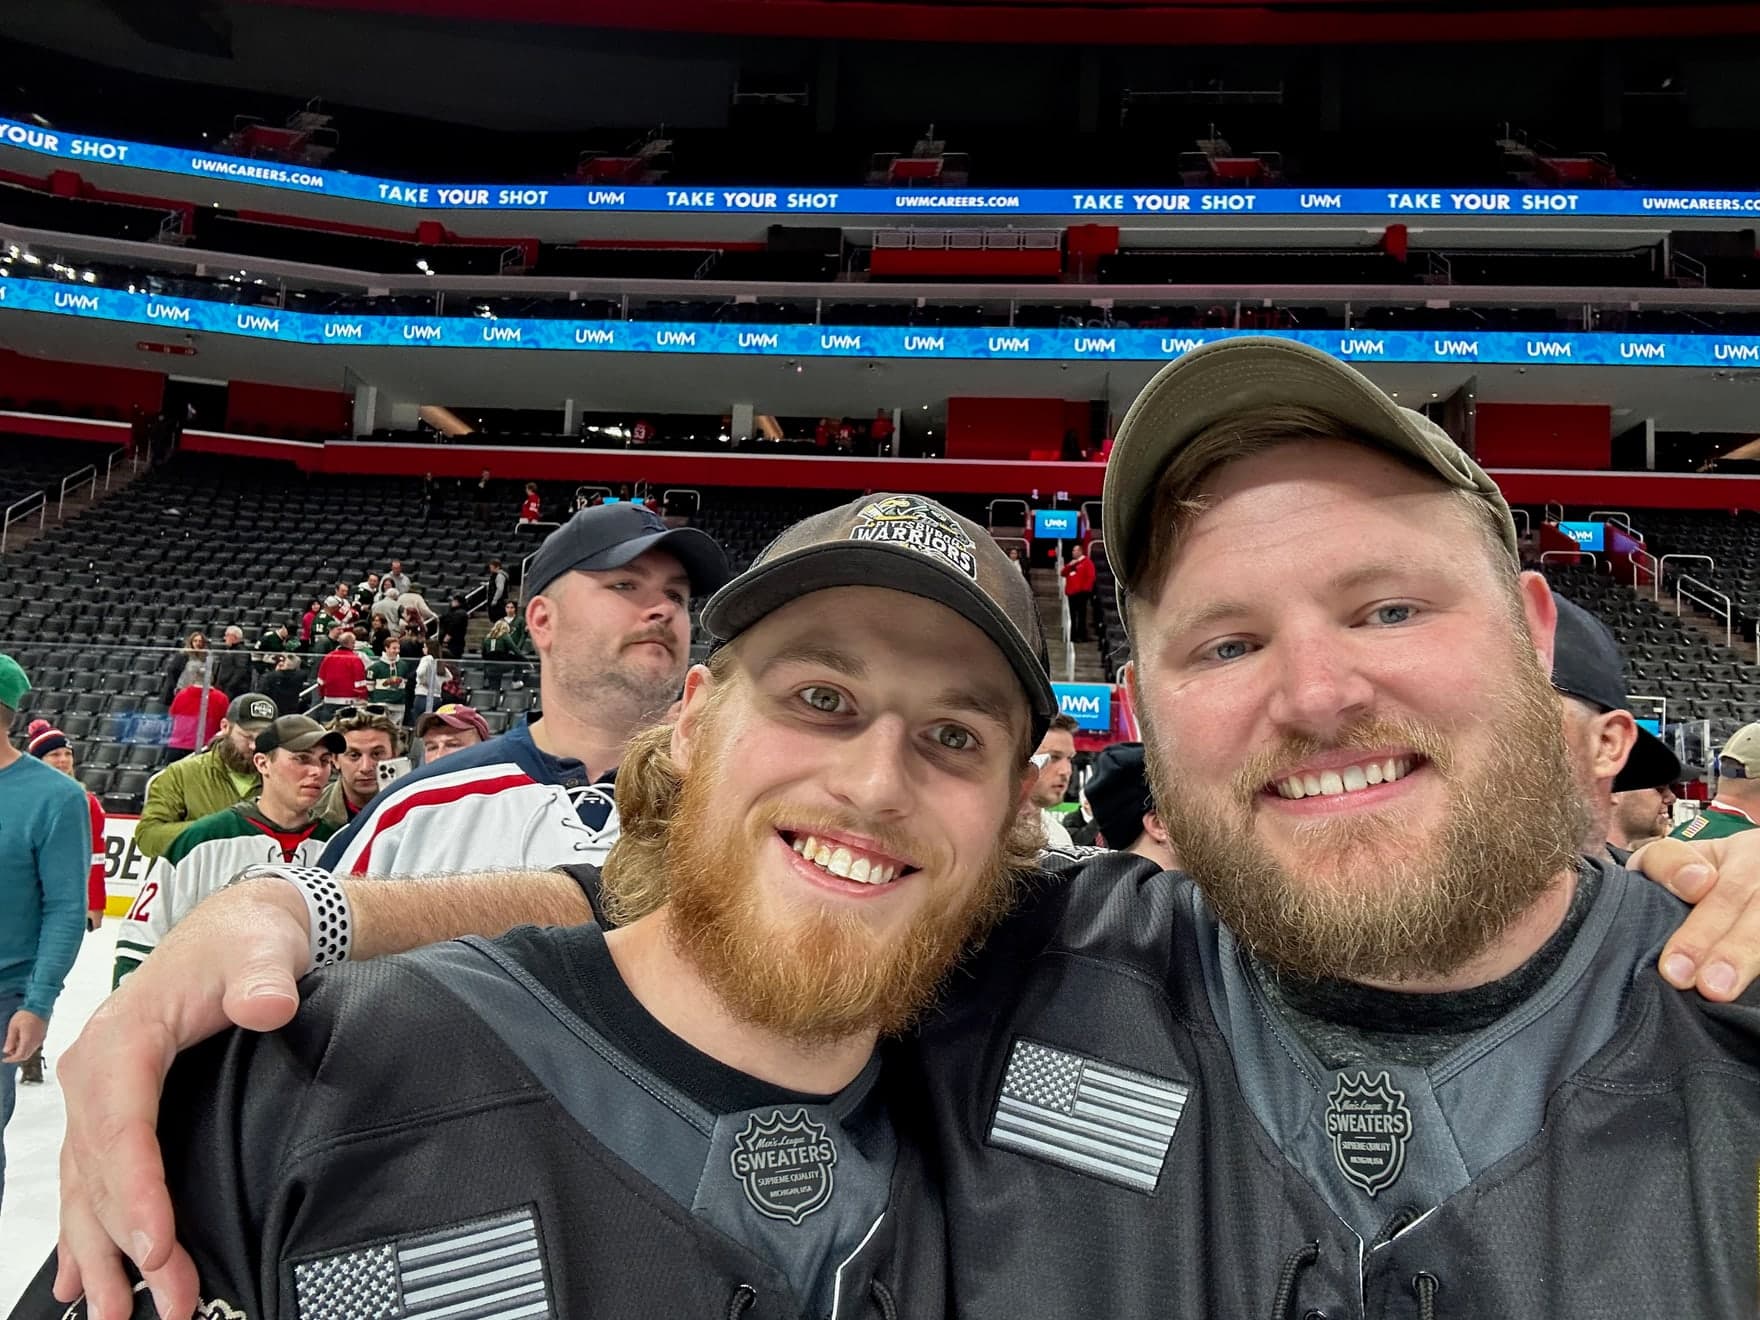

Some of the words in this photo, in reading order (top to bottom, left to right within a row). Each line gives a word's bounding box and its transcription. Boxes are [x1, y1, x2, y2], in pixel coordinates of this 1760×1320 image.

[0, 123, 59, 152] YOUR
[70, 139, 128, 160] SHOT
[191, 158, 324, 187] UWMCAREERS.COM
[378, 184, 429, 203] TAKE
[437, 189, 489, 205] YOUR
[498, 190, 549, 205] SHOT
[588, 191, 625, 205] UWM
[667, 191, 714, 206] TAKE
[723, 192, 777, 208] YOUR
[787, 193, 838, 208] SHOT
[895, 195, 1019, 208] UWMCAREERS.COM
[1073, 195, 1123, 209] TAKE
[1133, 194, 1190, 210] YOUR
[1201, 194, 1256, 210] SHOT
[1300, 194, 1341, 208] UWM
[1388, 193, 1441, 209] TAKE
[1450, 193, 1511, 210] YOUR
[1522, 194, 1578, 210] SHOT
[54, 292, 99, 310] UWM
[147, 303, 190, 322] UWM
[237, 314, 279, 332] UWM
[324, 324, 362, 338] UWM
[403, 325, 441, 339] UWM
[483, 327, 521, 341] UWM
[575, 329, 614, 343] UWM
[656, 332, 695, 346] UWM
[738, 333, 778, 347] UWM
[821, 335, 860, 349] UWM
[904, 336, 944, 350] UWM
[988, 337, 1029, 352] UWM
[1074, 338, 1115, 353] UWM
[1340, 339, 1384, 355] UWM
[1435, 340, 1478, 355] UWM
[1527, 341, 1571, 357] UWM
[1620, 343, 1665, 358] UWM
[1714, 344, 1760, 360] UWM
[858, 528, 971, 571] WARRIORS
[1329, 1113, 1405, 1134] SWEATERS
[736, 1143, 832, 1172] SWEATERS
[758, 1174, 790, 1186] SUPREME
[790, 1170, 819, 1182] QUALITY
